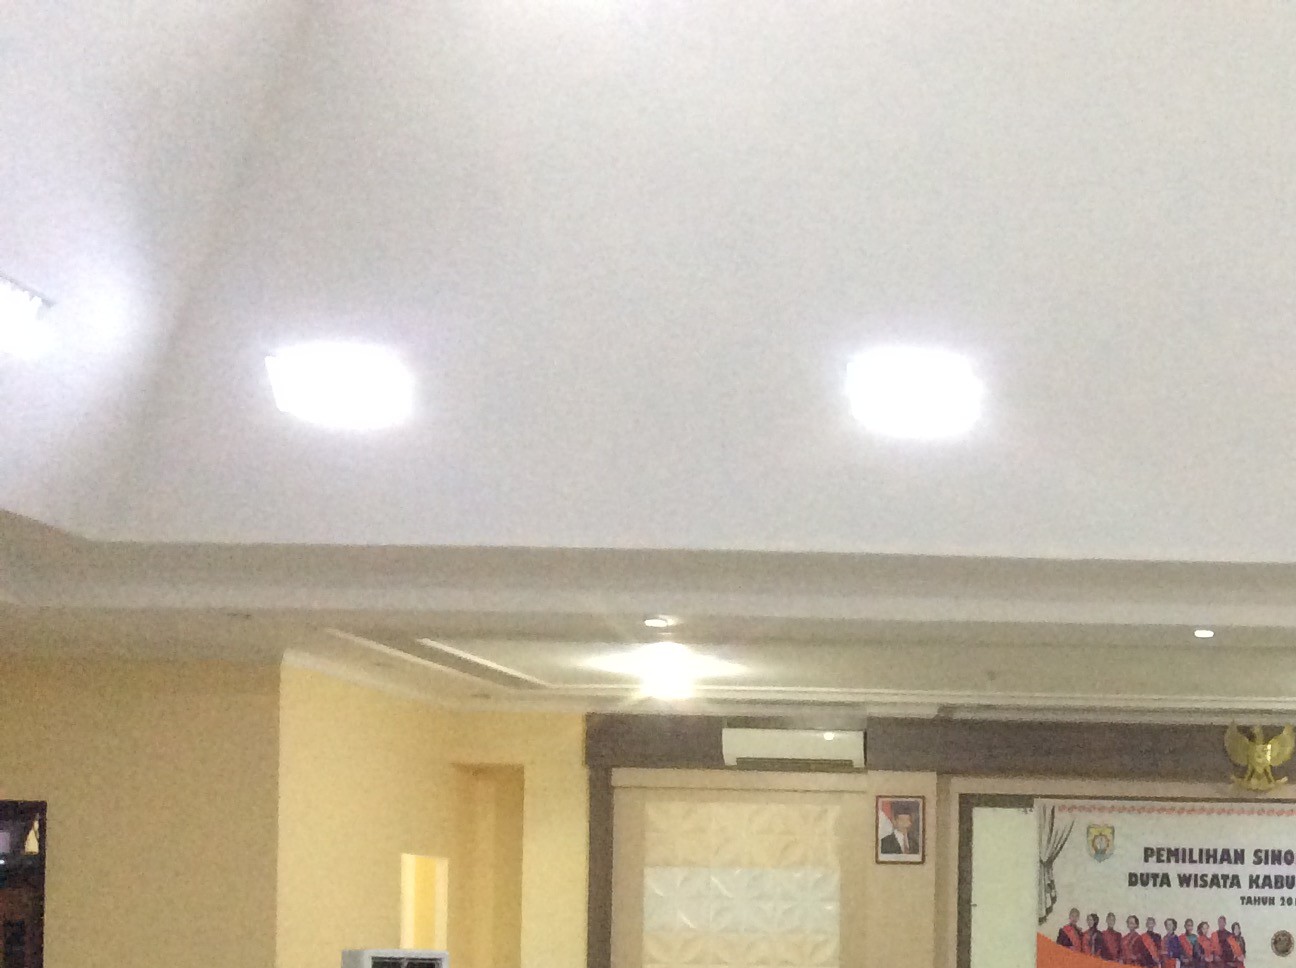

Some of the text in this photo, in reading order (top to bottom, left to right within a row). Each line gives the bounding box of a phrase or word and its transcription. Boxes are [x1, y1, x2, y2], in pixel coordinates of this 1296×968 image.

[1143, 846, 1245, 865] PEMILIHAN
[1128, 872, 1171, 888] DUTA
[1177, 872, 1242, 889] WISATA
[1239, 896, 1276, 906] TAHUN
